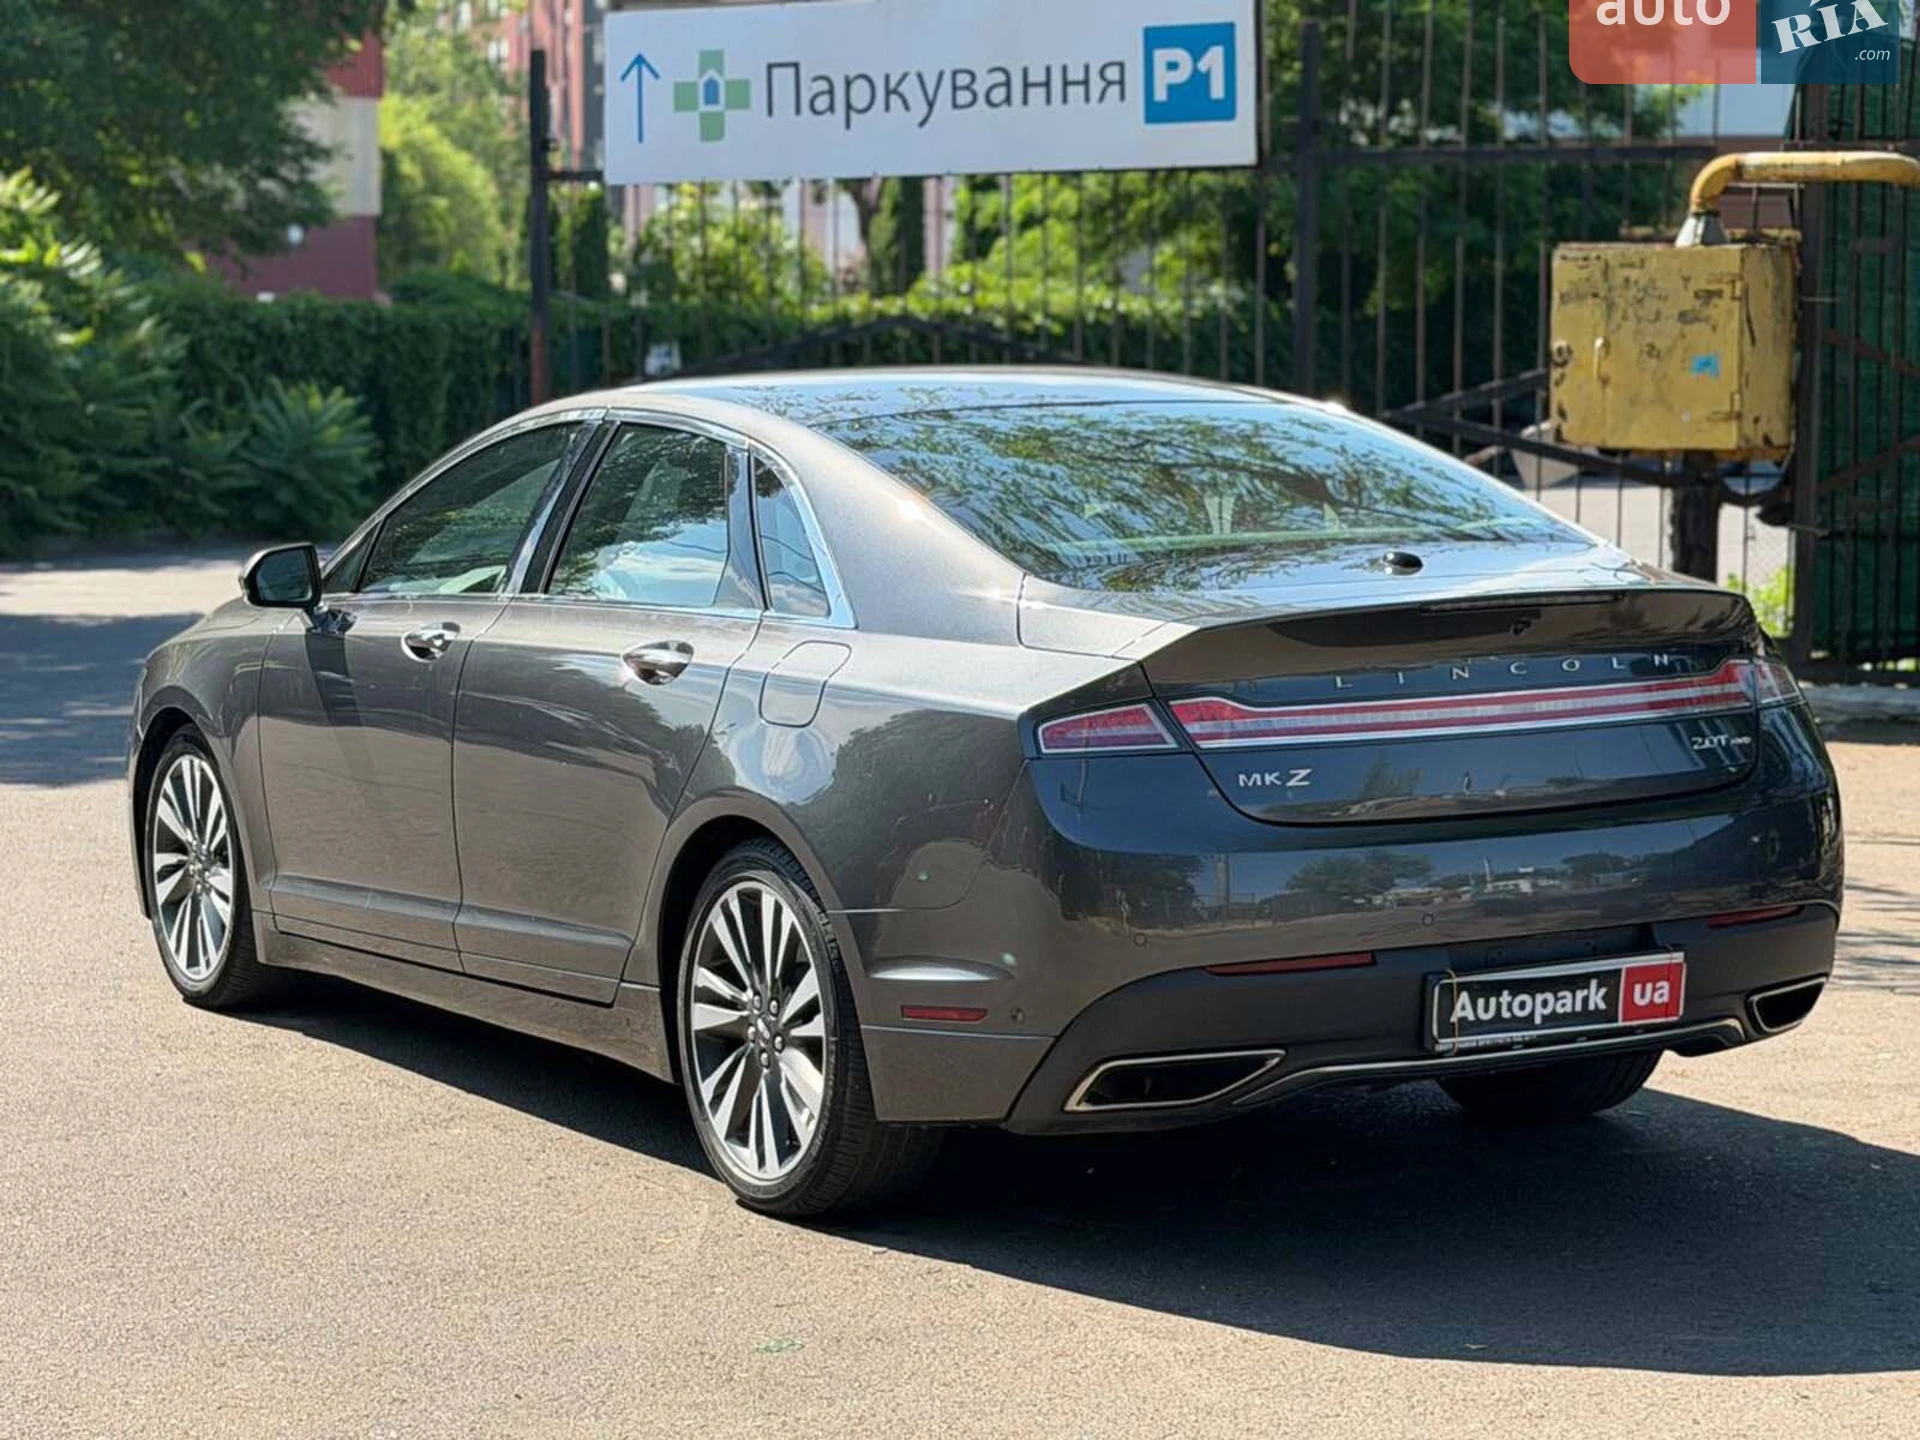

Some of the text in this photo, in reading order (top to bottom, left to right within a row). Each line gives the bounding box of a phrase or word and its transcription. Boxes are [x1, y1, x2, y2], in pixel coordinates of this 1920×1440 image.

[765, 59, 1126, 131] Паркування
[1152, 44, 1225, 103] P1
[1335, 653, 1670, 689] LINCOLN
[1449, 978, 1671, 1024] Autopark ua
